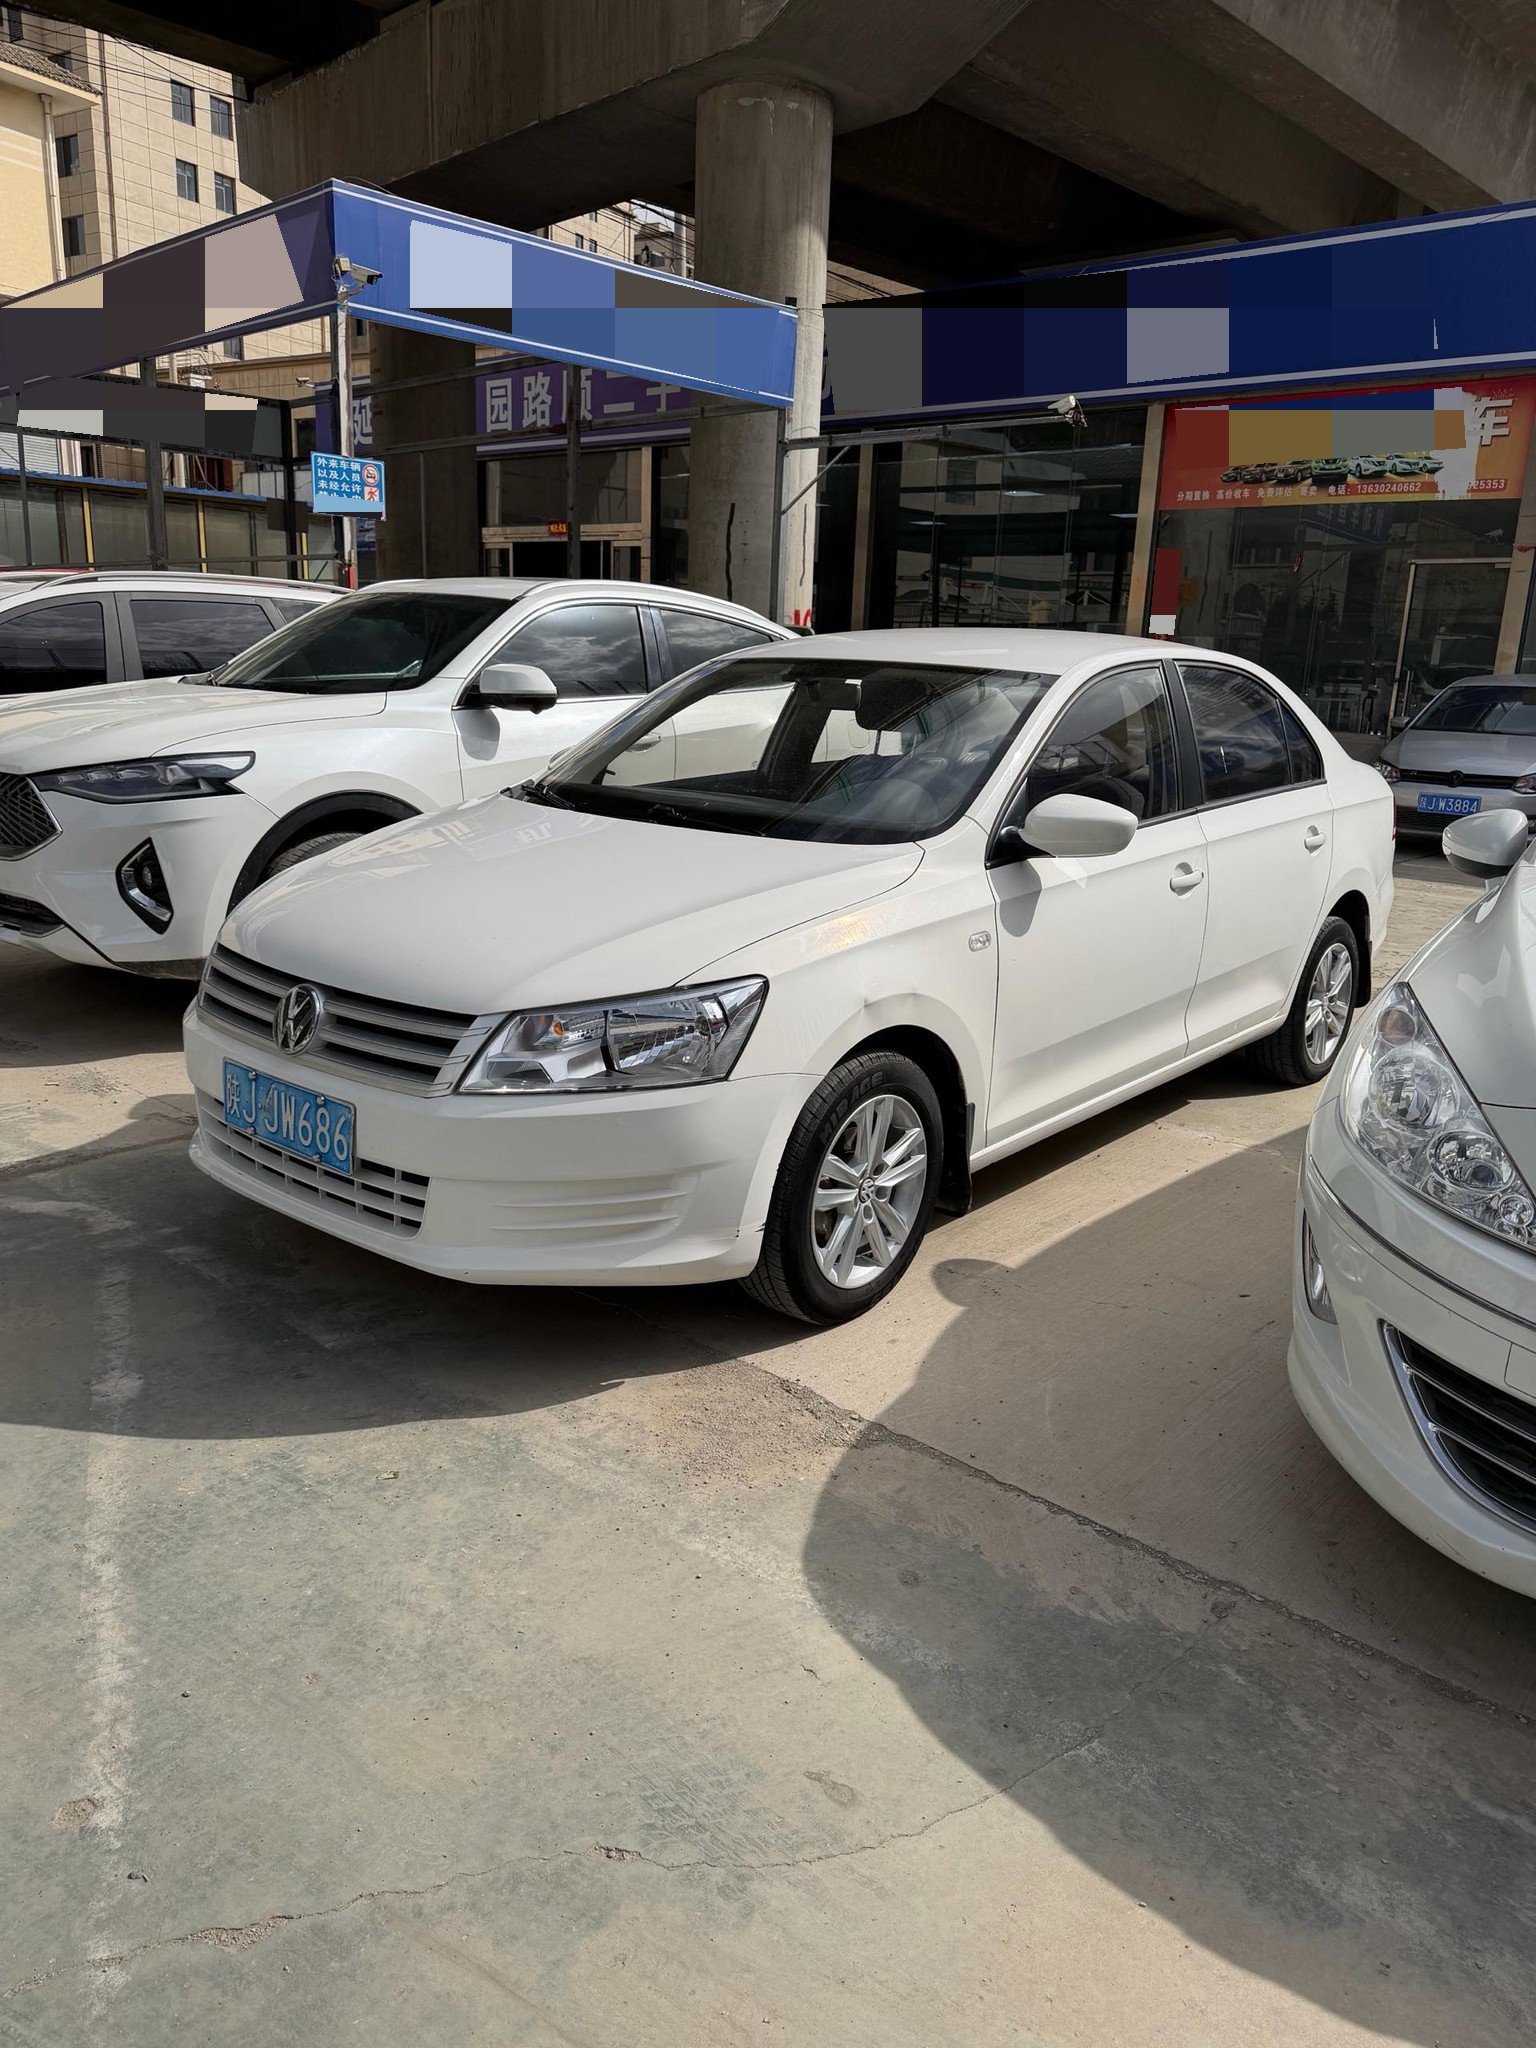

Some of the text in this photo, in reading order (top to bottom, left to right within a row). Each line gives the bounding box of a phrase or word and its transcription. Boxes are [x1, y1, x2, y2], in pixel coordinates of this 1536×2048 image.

[316, 457, 361, 472] 外来车辆
[317, 469, 361, 483] 以及人员
[318, 479, 362, 494] 未经允许
[819, 1070, 884, 1144] MIRAGE
